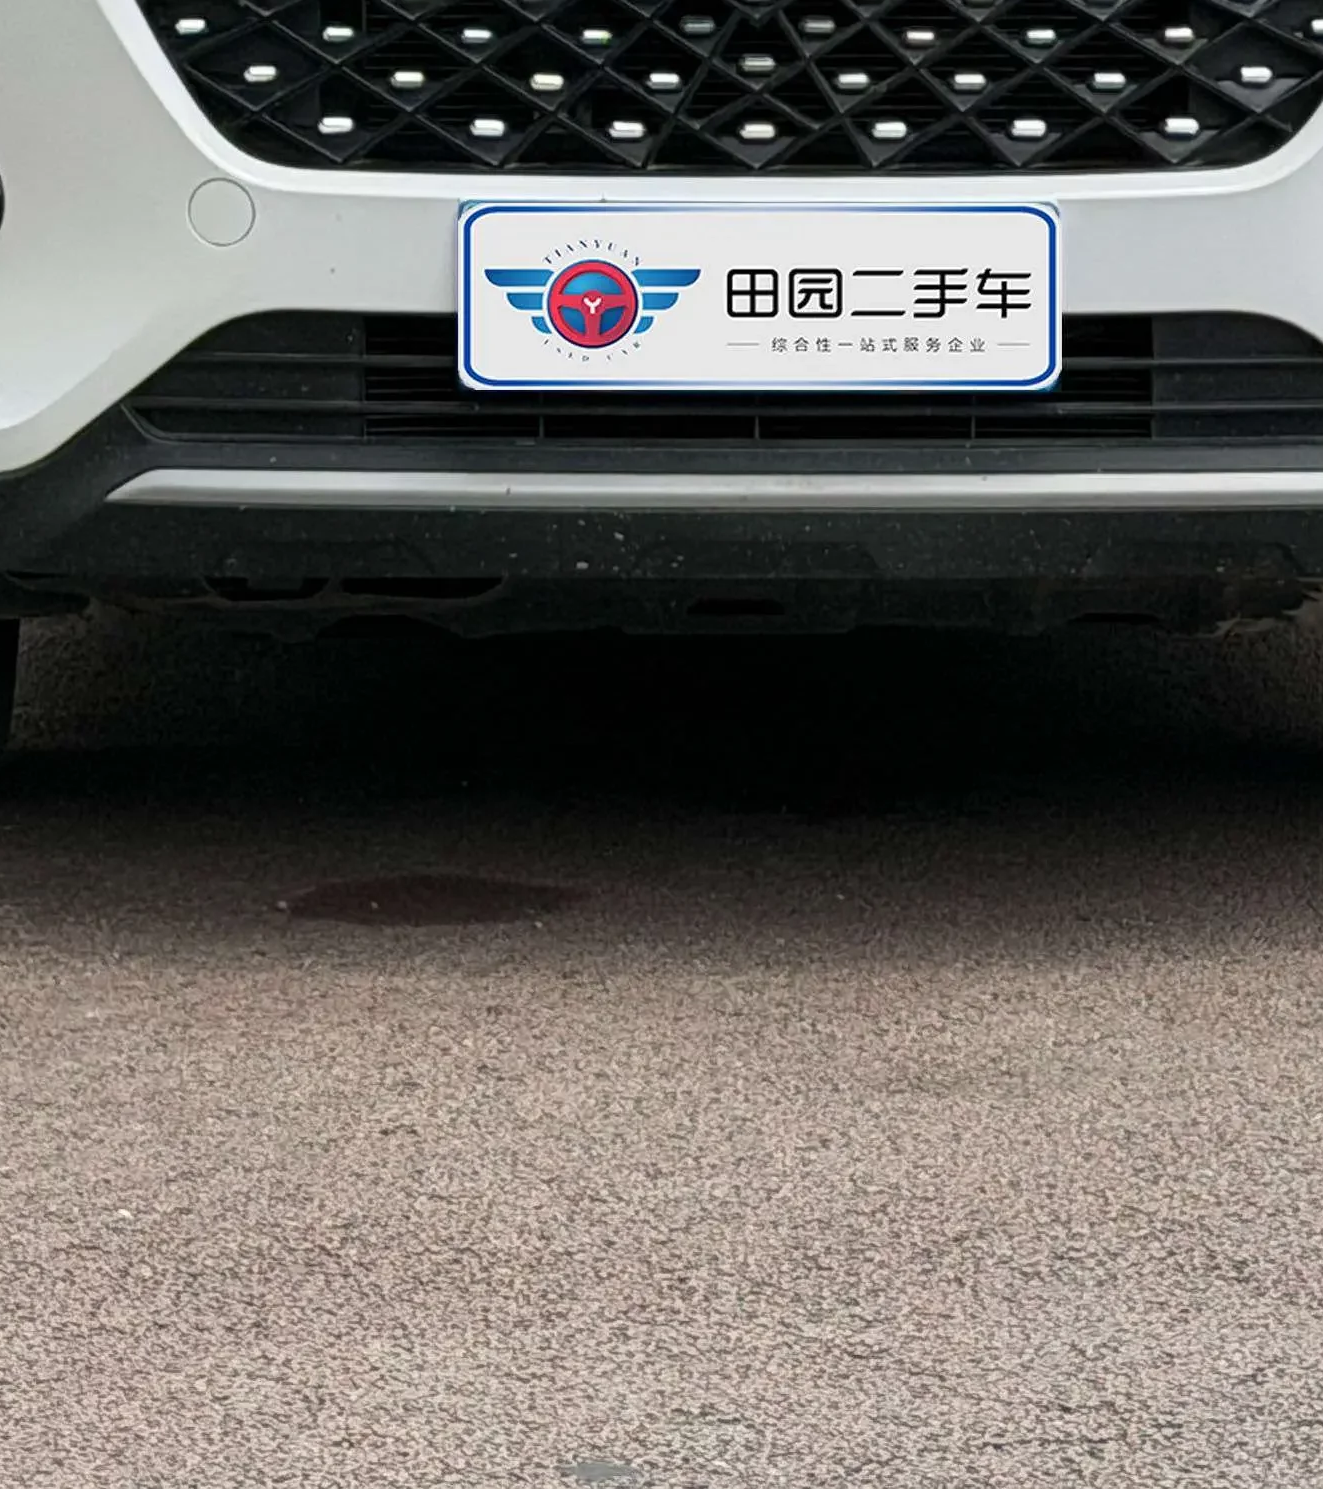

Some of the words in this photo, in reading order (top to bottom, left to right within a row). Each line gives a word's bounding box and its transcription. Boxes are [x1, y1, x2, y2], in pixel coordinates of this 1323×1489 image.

[727, 268, 1032, 319] 田园二手车
[772, 337, 986, 353] 综合性一站式服务企业
